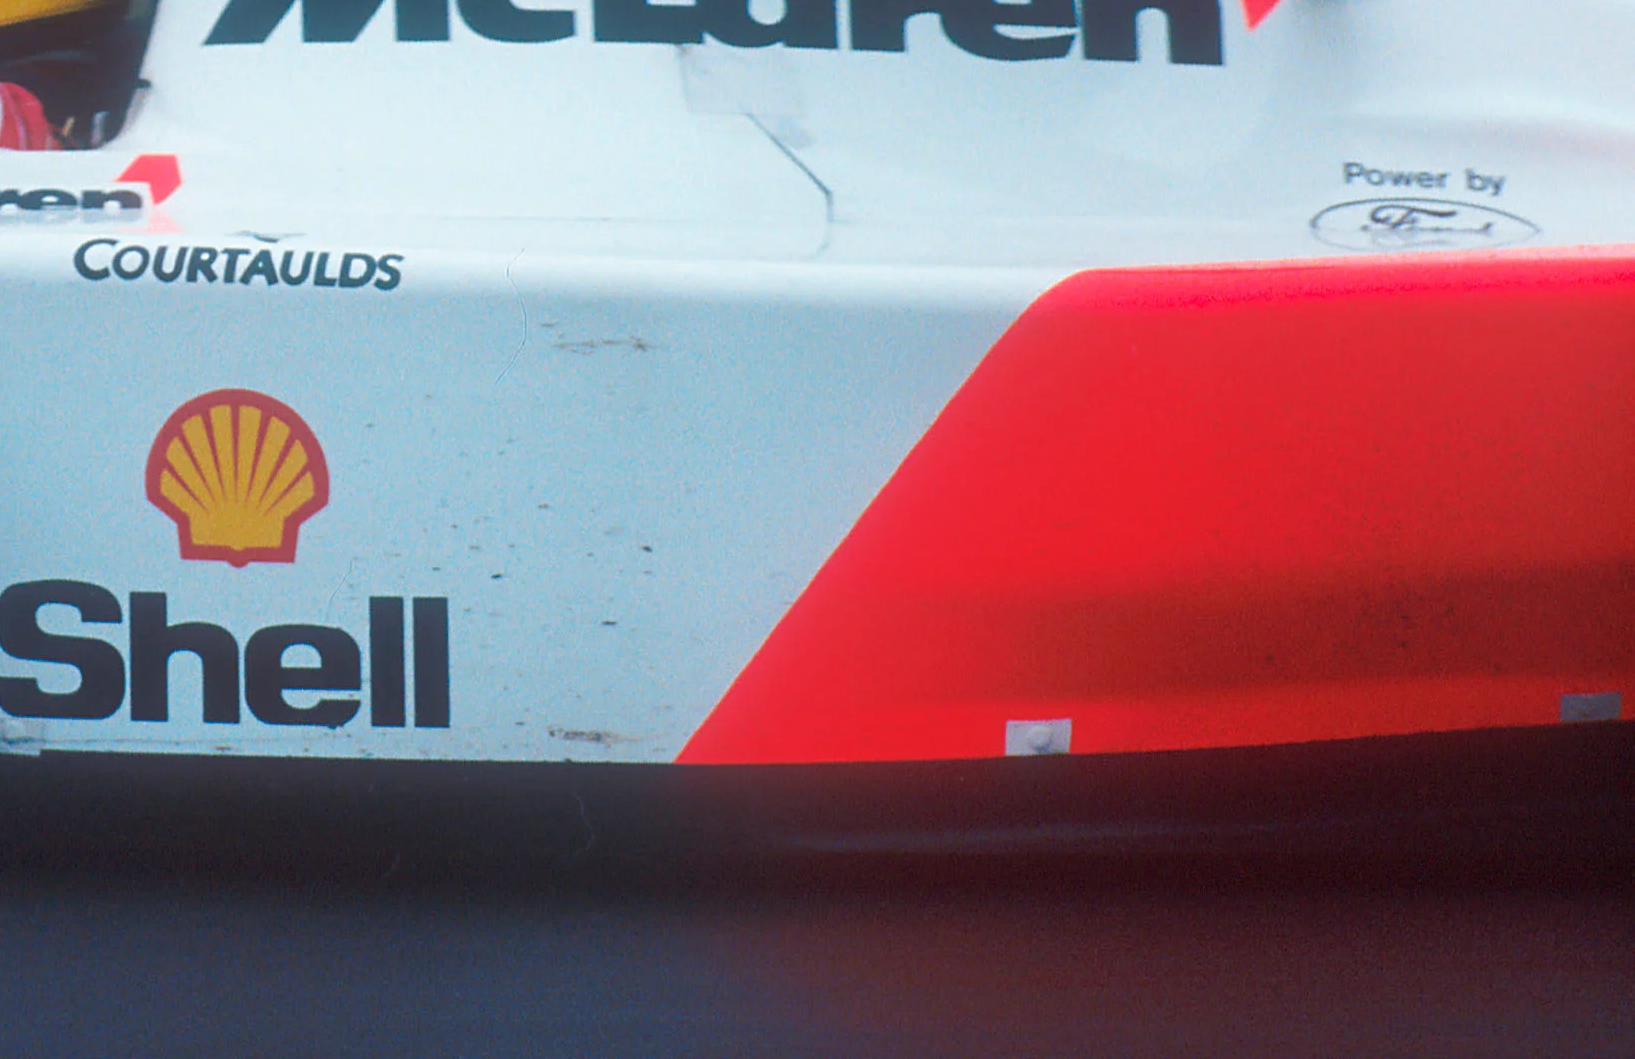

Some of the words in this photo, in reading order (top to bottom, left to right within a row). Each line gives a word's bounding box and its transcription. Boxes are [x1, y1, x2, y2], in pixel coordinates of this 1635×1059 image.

[1341, 161, 1450, 189] Power
[1465, 168, 1506, 196] by
[74, 238, 405, 291] COURTAULDS
